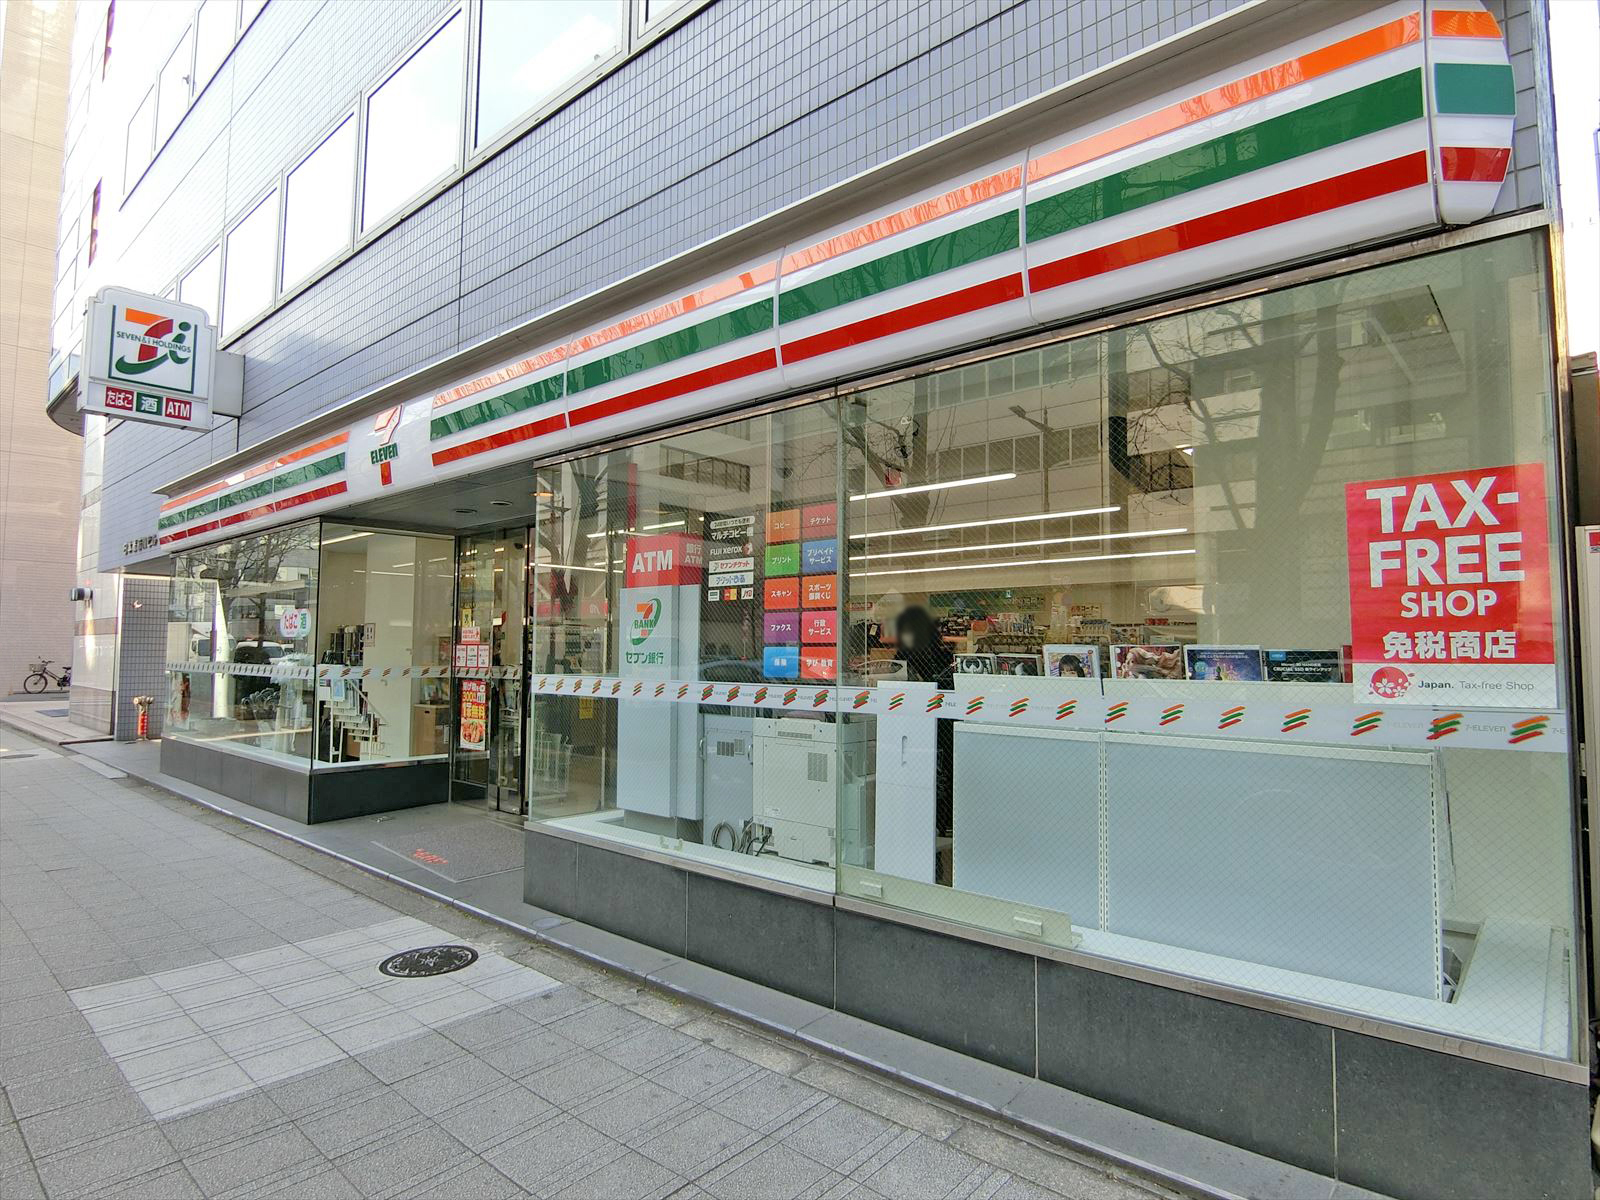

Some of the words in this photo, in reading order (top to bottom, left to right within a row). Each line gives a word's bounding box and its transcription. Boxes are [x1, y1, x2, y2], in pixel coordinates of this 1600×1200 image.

[152, 338, 192, 353] HOLDINGS
[106, 390, 133, 408] たばこ
[141, 396, 159, 412] 酒
[166, 401, 190, 418] ATM
[1366, 475, 1519, 534] TAX-
[809, 516, 831, 525] チケット
[632, 549, 673, 574] ATM
[684, 555, 703, 565] ATM
[771, 556, 792, 565] プリント
[809, 556, 832, 565] サービス
[1368, 531, 1526, 588] FREE
[808, 583, 832, 592] スポーツ
[770, 590, 792, 598] スキャン
[808, 592, 831, 600] くじ
[1400, 589, 1498, 618] SHOP
[634, 619, 656, 629] BANK
[770, 624, 792, 632] ファクス
[808, 627, 832, 636] サービス
[1382, 630, 1517, 659] 免税商店
[625, 651, 664, 664] セブン銀行
[1417, 680, 1455, 690] Japan.
[1459, 680, 1502, 690] Tax-free
[1505, 681, 1535, 692] Shop
